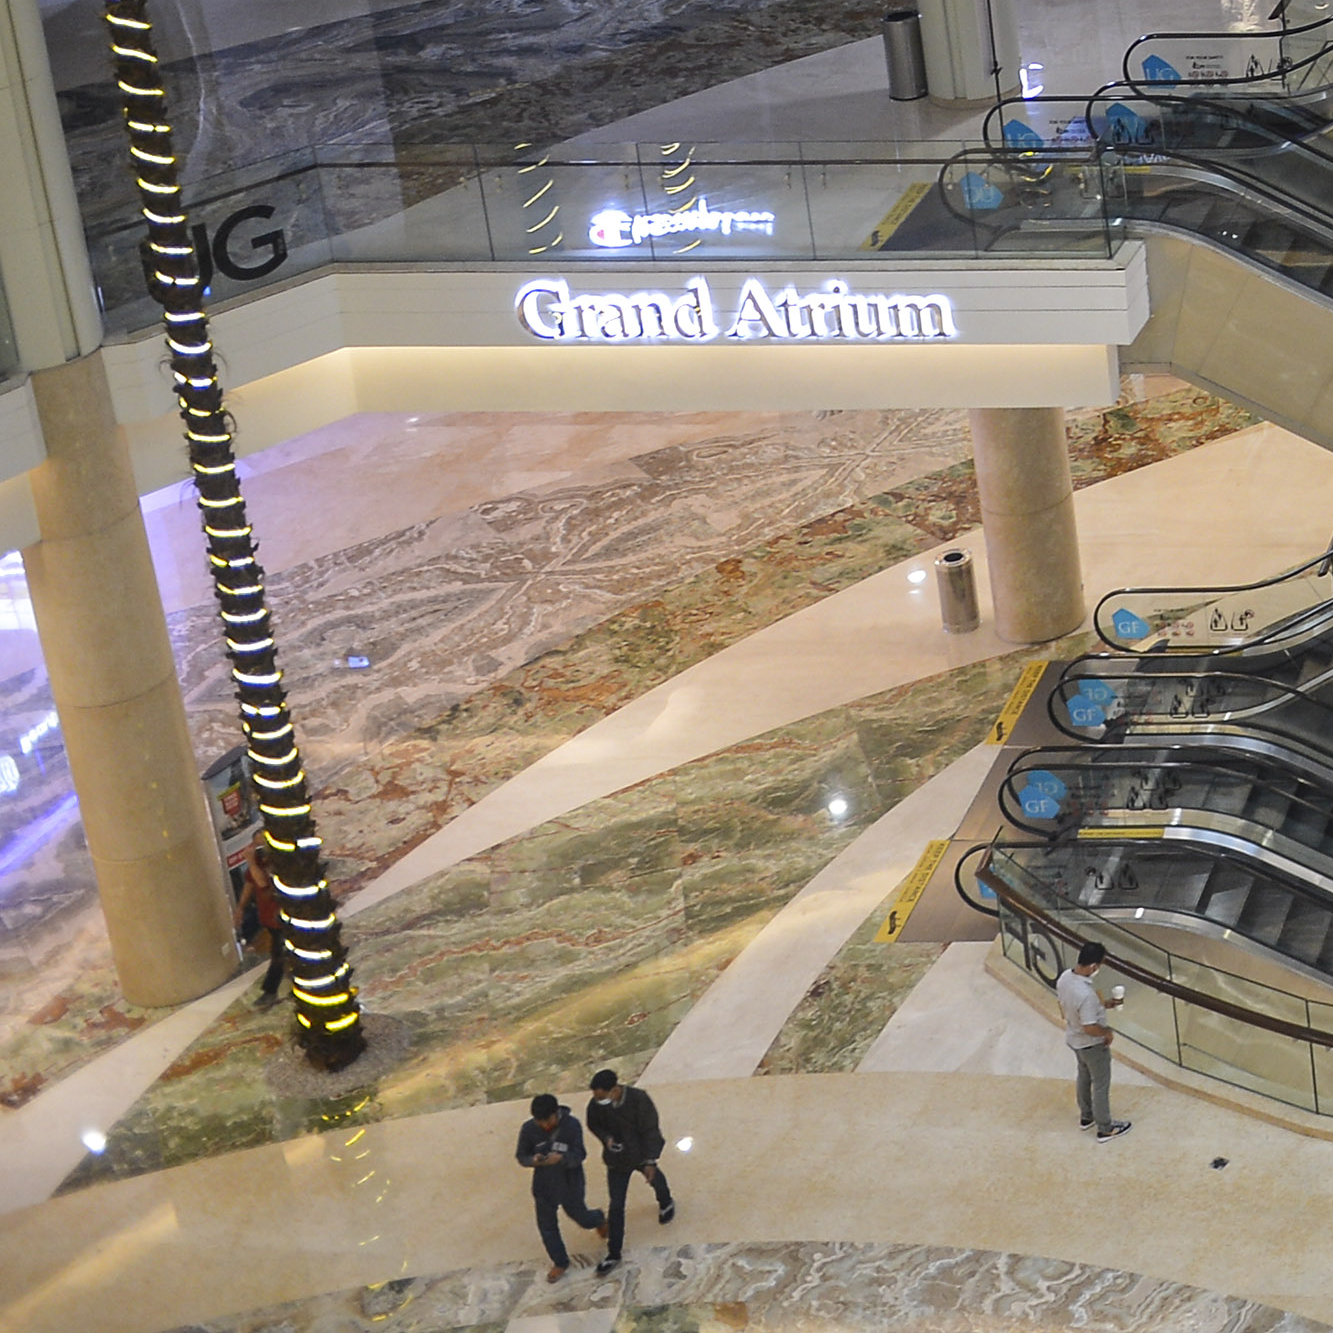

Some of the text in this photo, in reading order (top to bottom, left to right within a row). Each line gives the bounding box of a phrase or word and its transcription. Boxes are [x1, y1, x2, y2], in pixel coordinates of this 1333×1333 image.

[515, 277, 957, 340] Grand Atrium
[1118, 622, 1140, 634] GF
[1073, 708, 1097, 721] GF
[1025, 800, 1049, 813] GF
